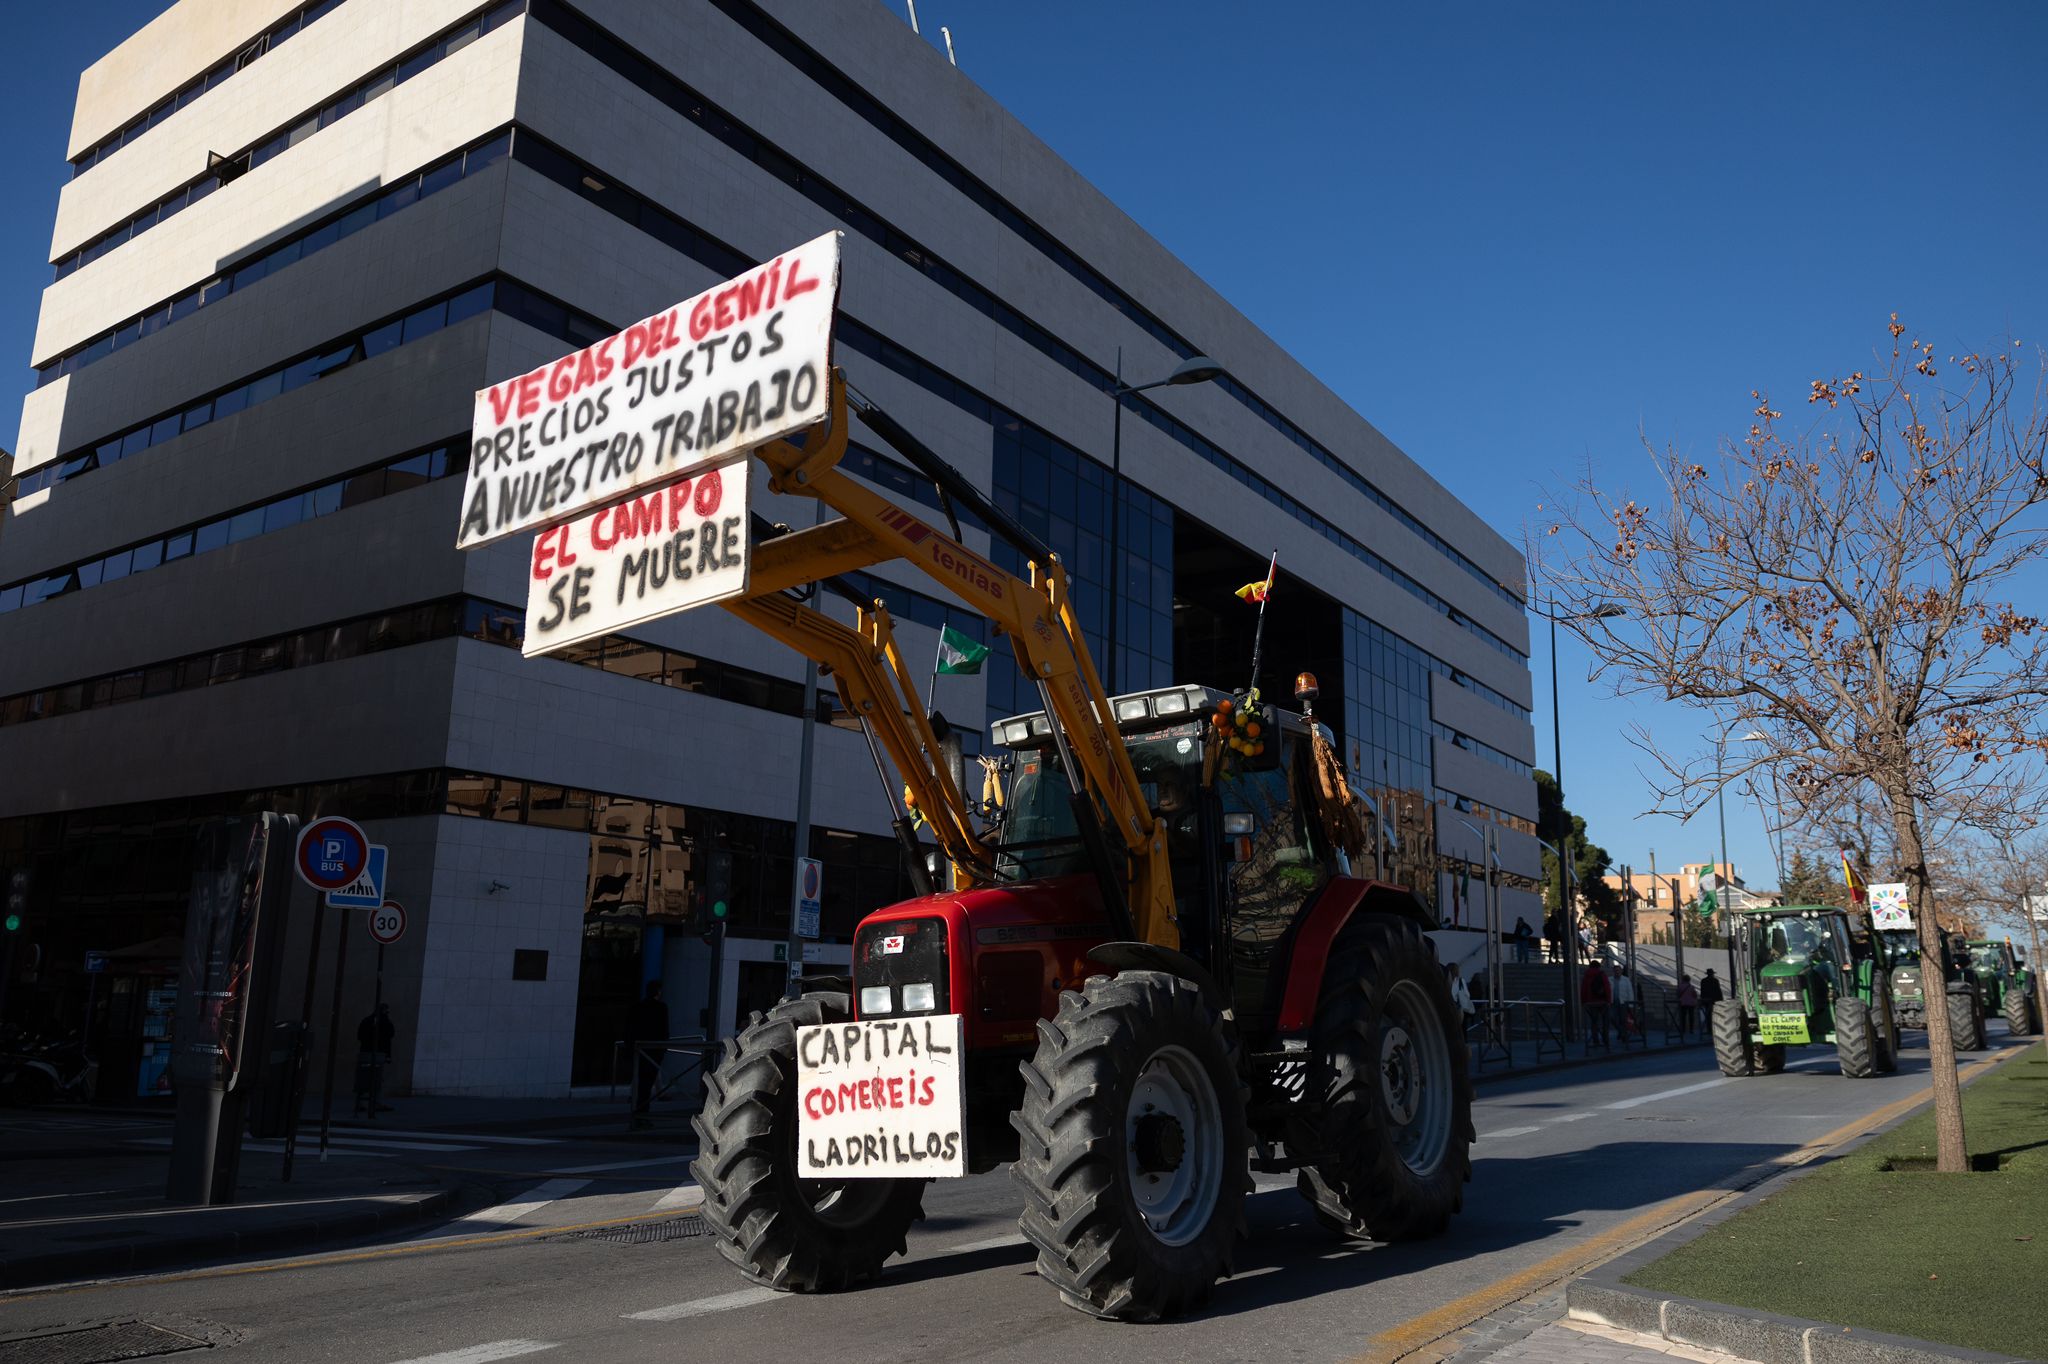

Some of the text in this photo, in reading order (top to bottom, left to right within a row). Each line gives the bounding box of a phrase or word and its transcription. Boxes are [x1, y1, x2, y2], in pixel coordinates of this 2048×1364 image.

[487, 342, 614, 425] VEGAS
[622, 307, 680, 370] DEL
[626, 310, 785, 408] JUSTOS
[461, 362, 819, 541] A NUESTRO TRABAJO
[533, 468, 723, 581] EL CAMPO
[537, 516, 742, 633] SE MUERE
[1090, 733, 1103, 757] 200
[321, 862, 344, 871] BUS
[326, 841, 341, 859] P
[377, 917, 398, 930] 30
